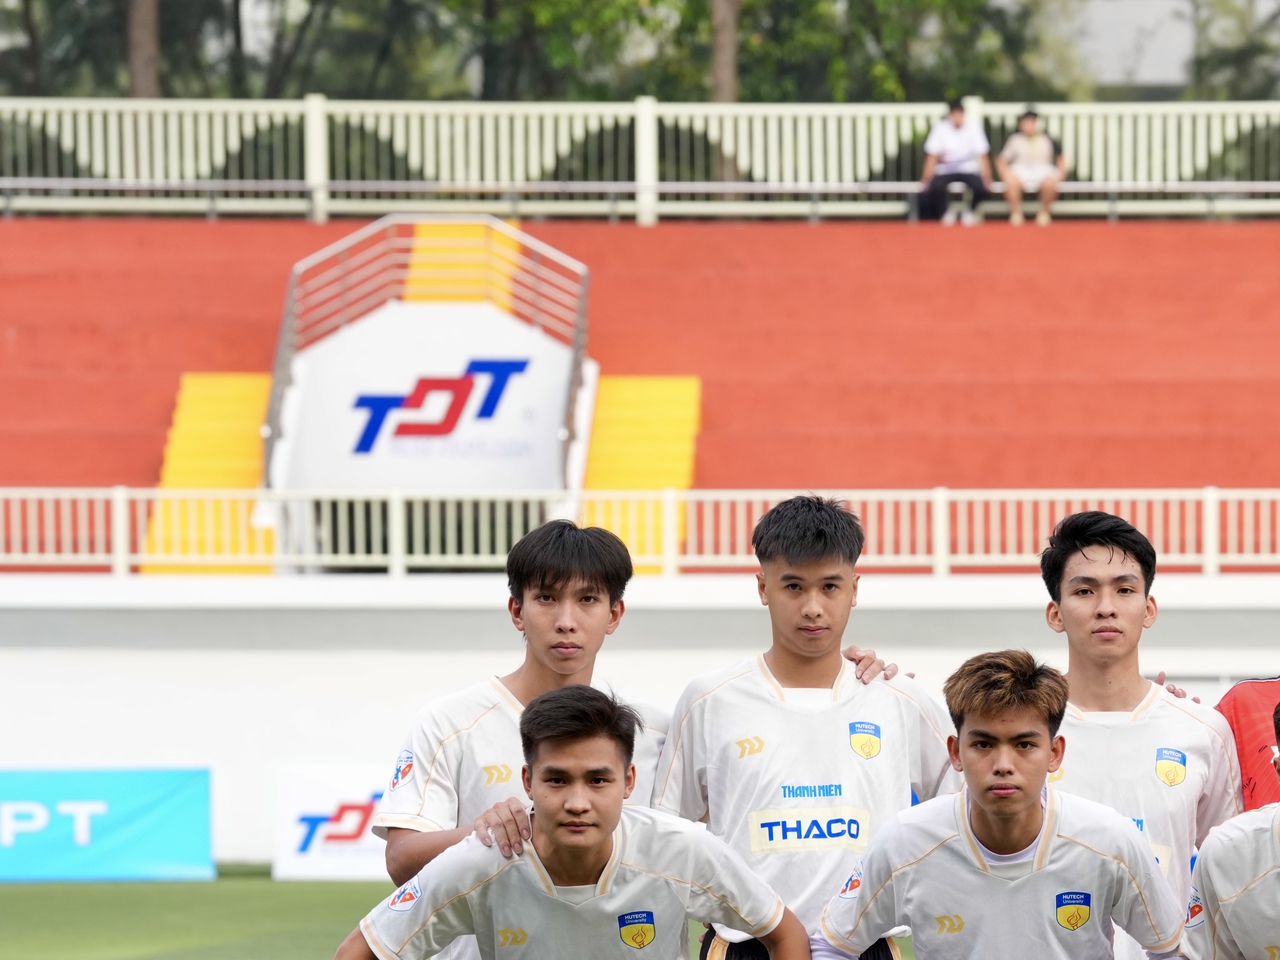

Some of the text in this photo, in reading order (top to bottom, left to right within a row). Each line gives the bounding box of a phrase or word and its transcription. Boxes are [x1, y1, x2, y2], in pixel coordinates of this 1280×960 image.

[1162, 749, 1182, 758] HUTECH
[781, 785, 817, 798] THANH
[760, 818, 860, 841] THACO
[624, 912, 647, 920] HUTECH
